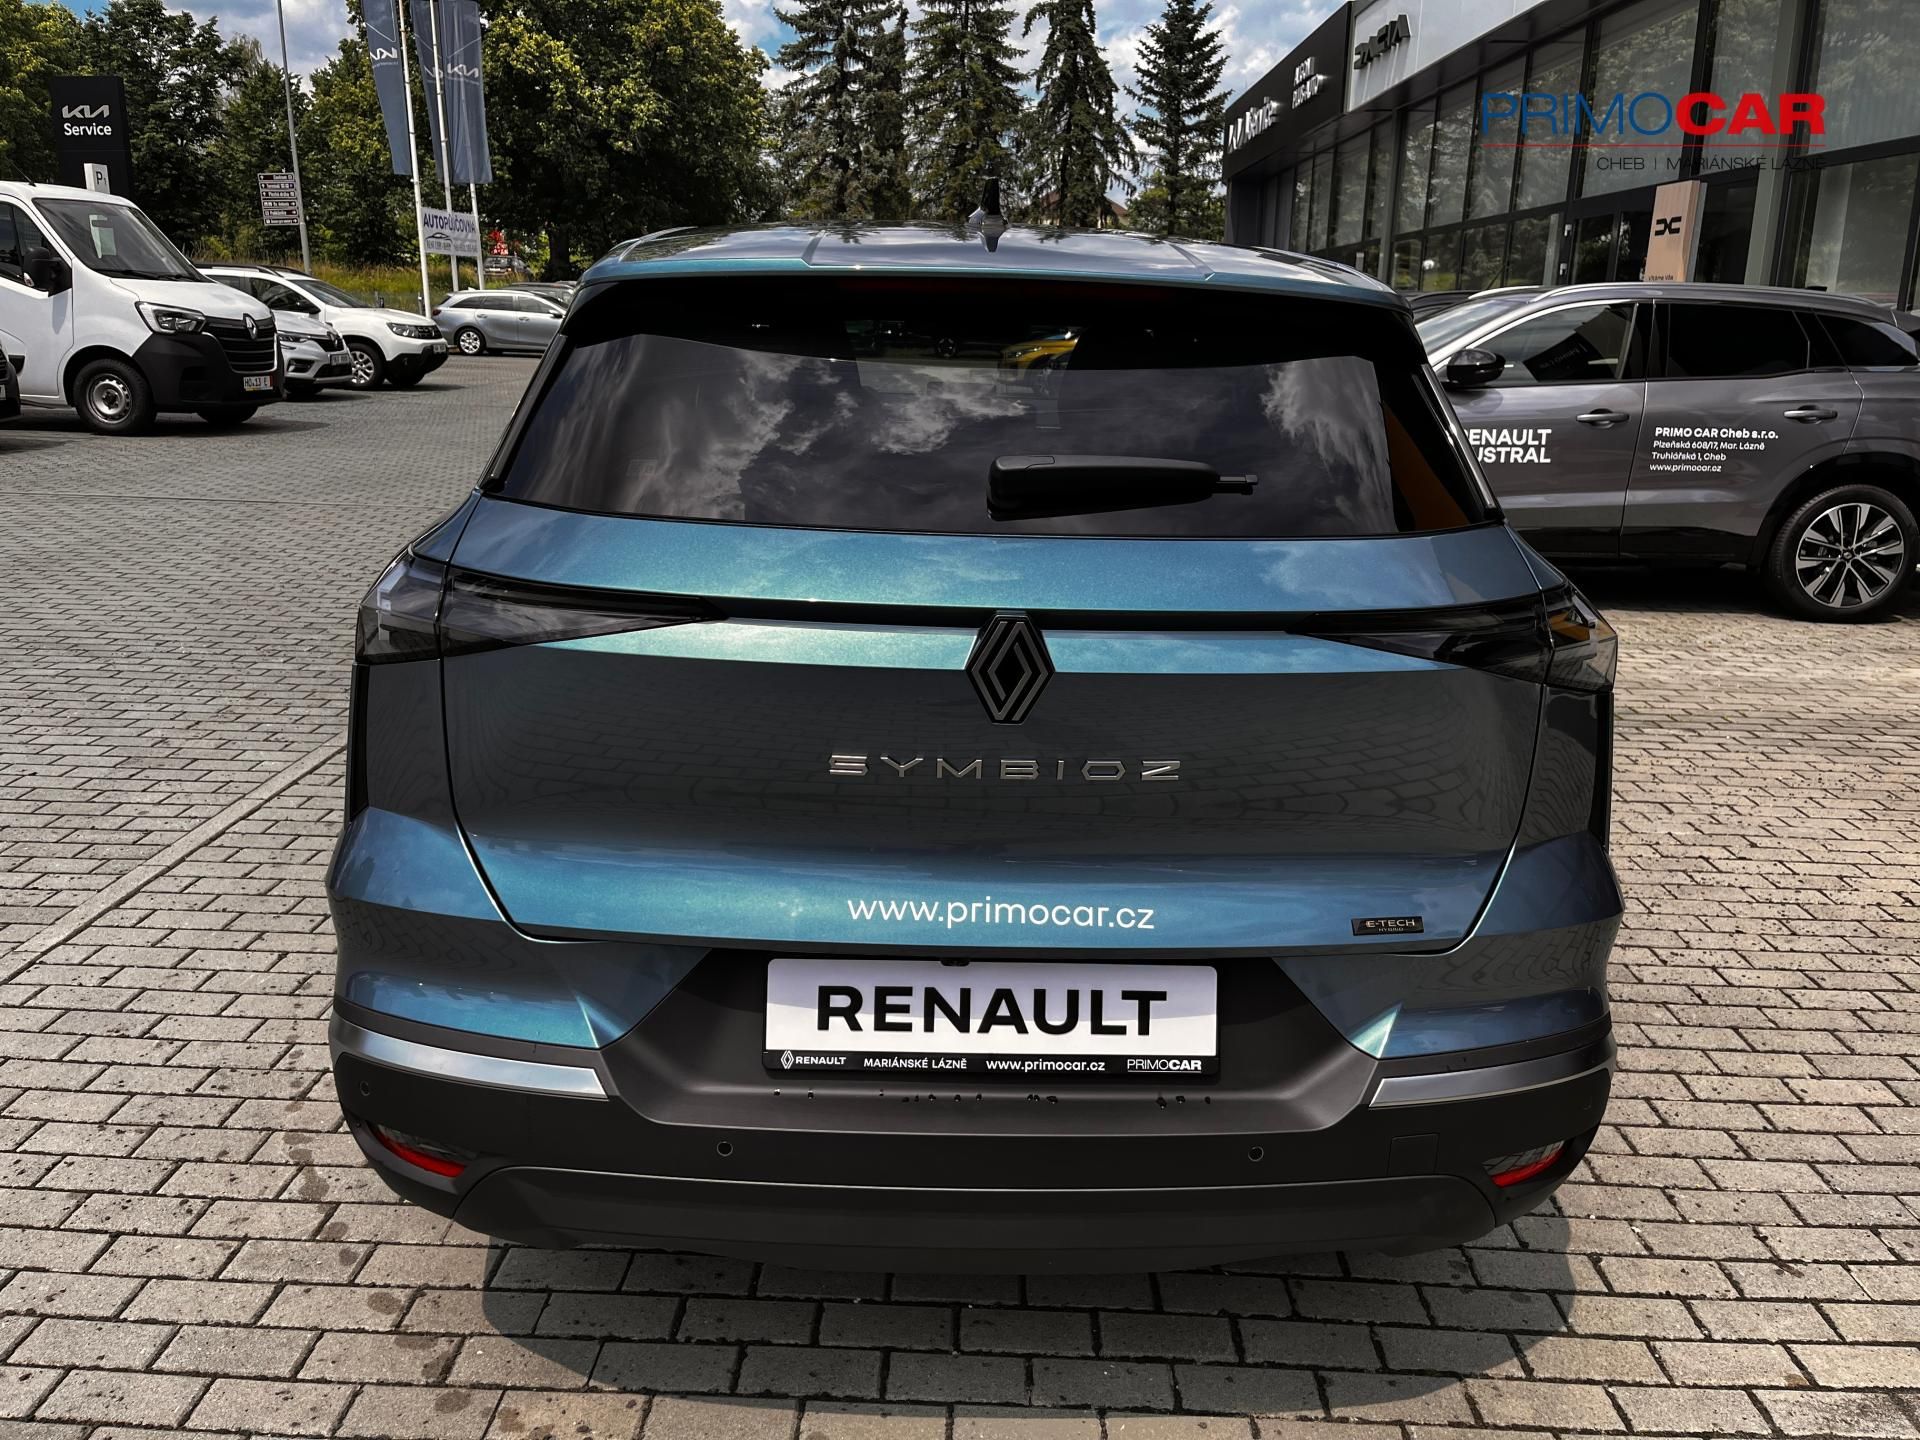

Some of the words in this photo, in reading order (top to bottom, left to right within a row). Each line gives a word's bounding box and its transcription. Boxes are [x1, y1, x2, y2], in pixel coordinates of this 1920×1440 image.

[61, 104, 110, 119] KIA
[63, 122, 113, 136] Service
[1463, 428, 1552, 446] ENAULT
[1655, 427, 1692, 438] PRIMO
[1694, 427, 1719, 438] CAR
[1720, 428, 1750, 438] Cheb
[1751, 430, 1779, 439] s.r.o.
[1691, 440, 1719, 450] 608/17,
[1719, 441, 1738, 450] Mar.
[1477, 446, 1552, 464] USTRAL
[1703, 452, 1727, 461] Cheb
[1649, 463, 1722, 472] www.primocar.cz
[828, 753, 1181, 781] SYMBIOZ
[847, 896, 1155, 929] www.primocar.cz
[1365, 918, 1416, 928] E-TECH
[817, 985, 1168, 1036] RENAULT
[795, 1056, 847, 1066] RENAULT
[863, 1056, 929, 1069] MARIÁNSKÉ
[931, 1057, 968, 1069] LÁZNĚ
[985, 1058, 1106, 1072] www.primocar.cz
[1127, 1058, 1202, 1071] PRIMOCAR
